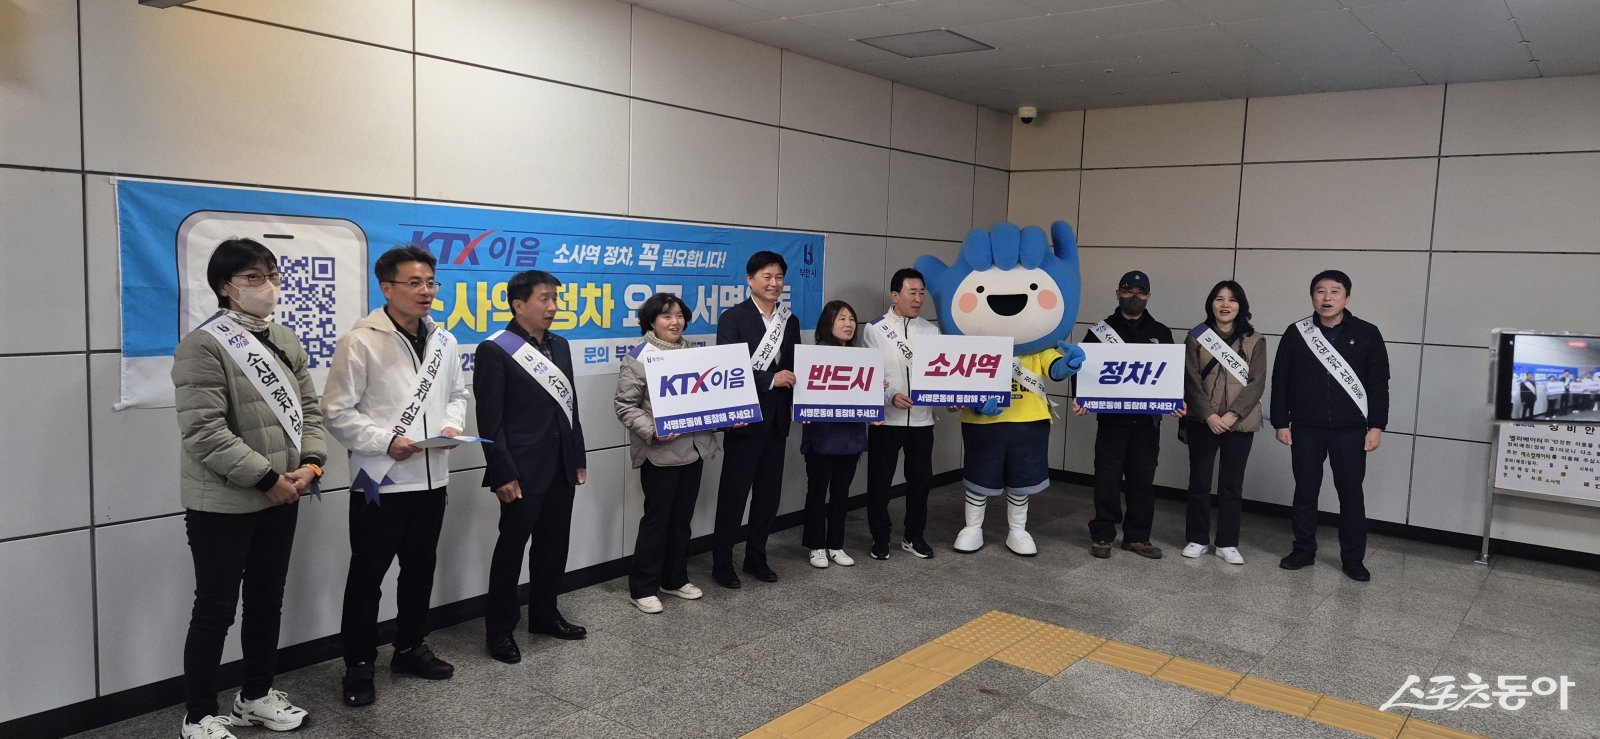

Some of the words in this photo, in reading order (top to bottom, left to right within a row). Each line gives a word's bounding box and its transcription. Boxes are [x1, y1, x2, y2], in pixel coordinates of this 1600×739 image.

[552, 243, 601, 265] 소사역
[603, 246, 634, 267] 정차,
[638, 243, 660, 271] 꼭
[662, 249, 727, 269] 필요합니다!
[800, 268, 817, 278] 부천시
[228, 332, 245, 346] KTX
[769, 323, 784, 345] 소사역
[584, 346, 609, 365] 문의
[759, 342, 773, 361] 정차
[1221, 351, 1242, 370] 소사역
[1311, 336, 1330, 355] 소사역
[1326, 353, 1342, 370] 정차
[427, 348, 443, 380] 소사역
[924, 353, 1002, 378] 소사역
[1099, 361, 1167, 385] 정차!
[247, 351, 279, 387] 소사역
[271, 385, 294, 413] 정차
[548, 375, 569, 399] 소사역
[807, 364, 875, 391] 반드시
[414, 377, 432, 403] 정차
[917, 394, 955, 403] 서명운동에
[956, 394, 978, 403] 동참해
[799, 408, 834, 418] 서명운동에
[835, 409, 856, 418] 동참해
[856, 409, 879, 418] 주세요!
[1082, 401, 1122, 410] 서명운동에
[1123, 401, 1148, 410] 동참해
[1149, 402, 1177, 411] 주세요!
[663, 416, 703, 431] 서명운동에
[703, 412, 728, 425] 동참해
[728, 409, 754, 421] 주세요!
